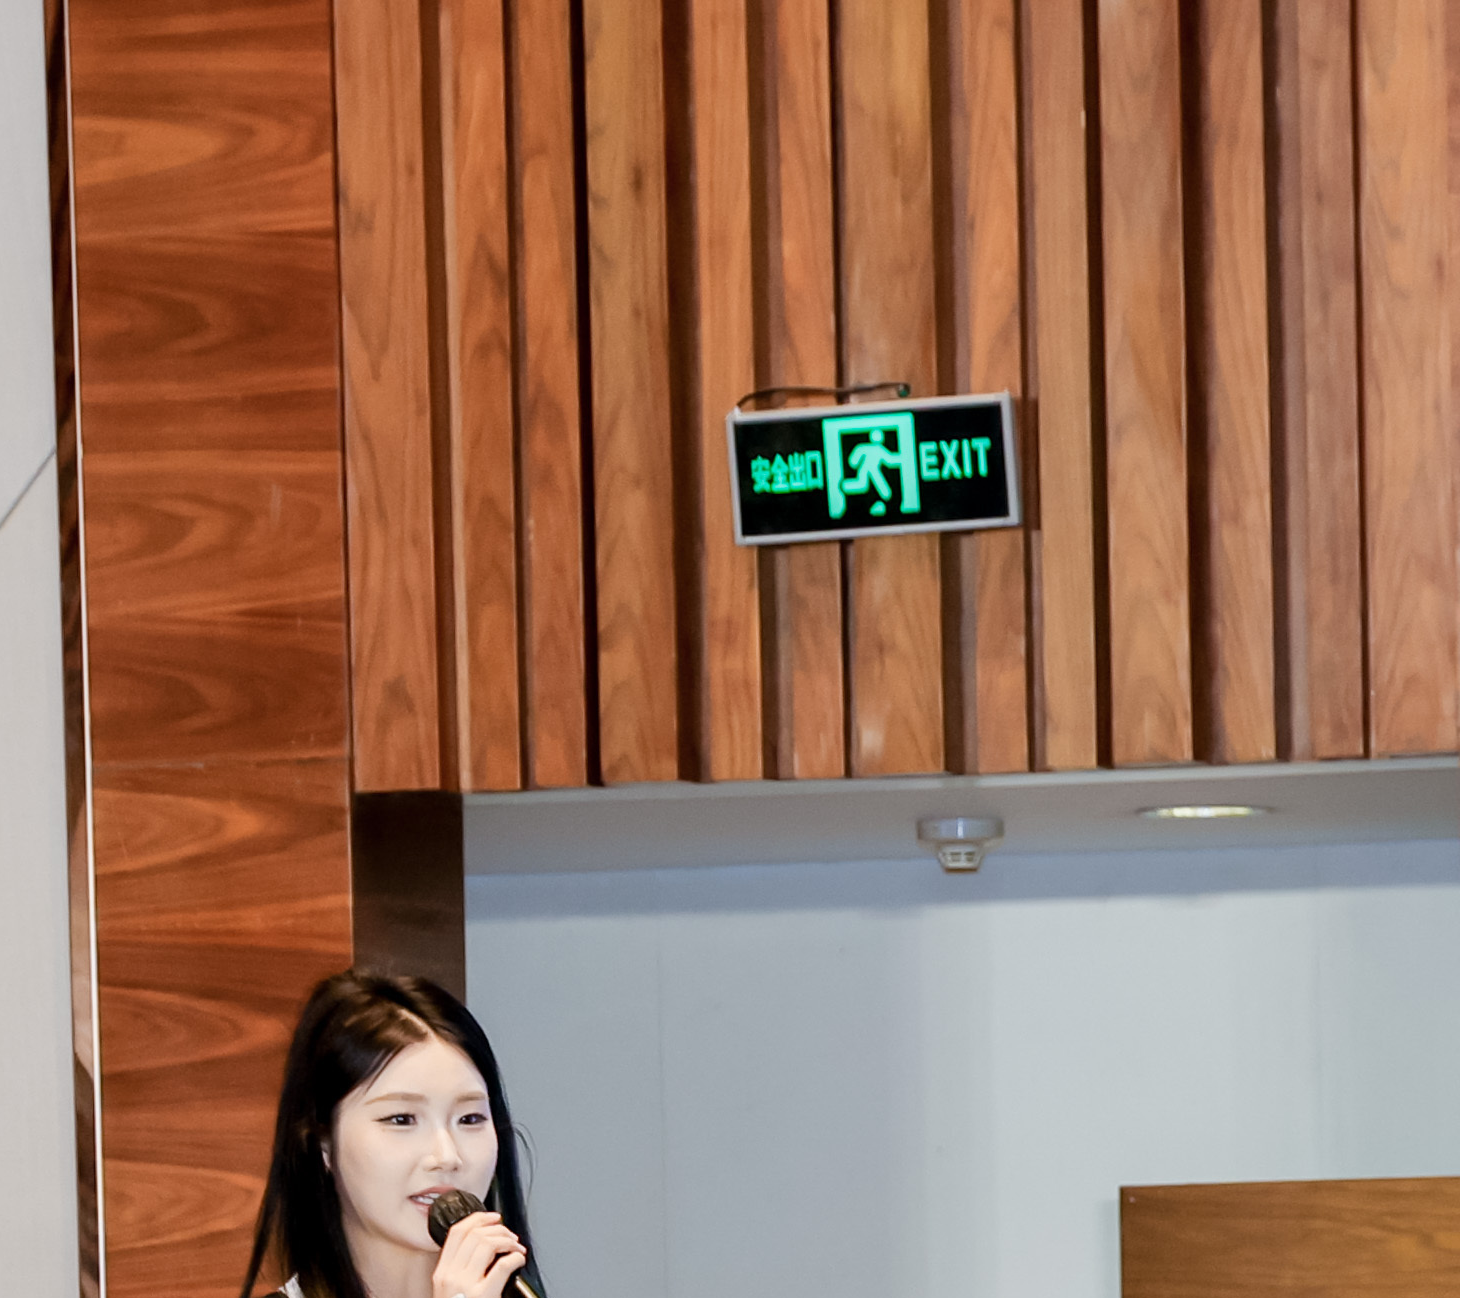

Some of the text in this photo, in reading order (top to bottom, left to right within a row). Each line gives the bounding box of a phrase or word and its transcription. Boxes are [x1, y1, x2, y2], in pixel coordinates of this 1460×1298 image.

[751, 450, 824, 493] 安全出口
[919, 437, 991, 481] EXIT
